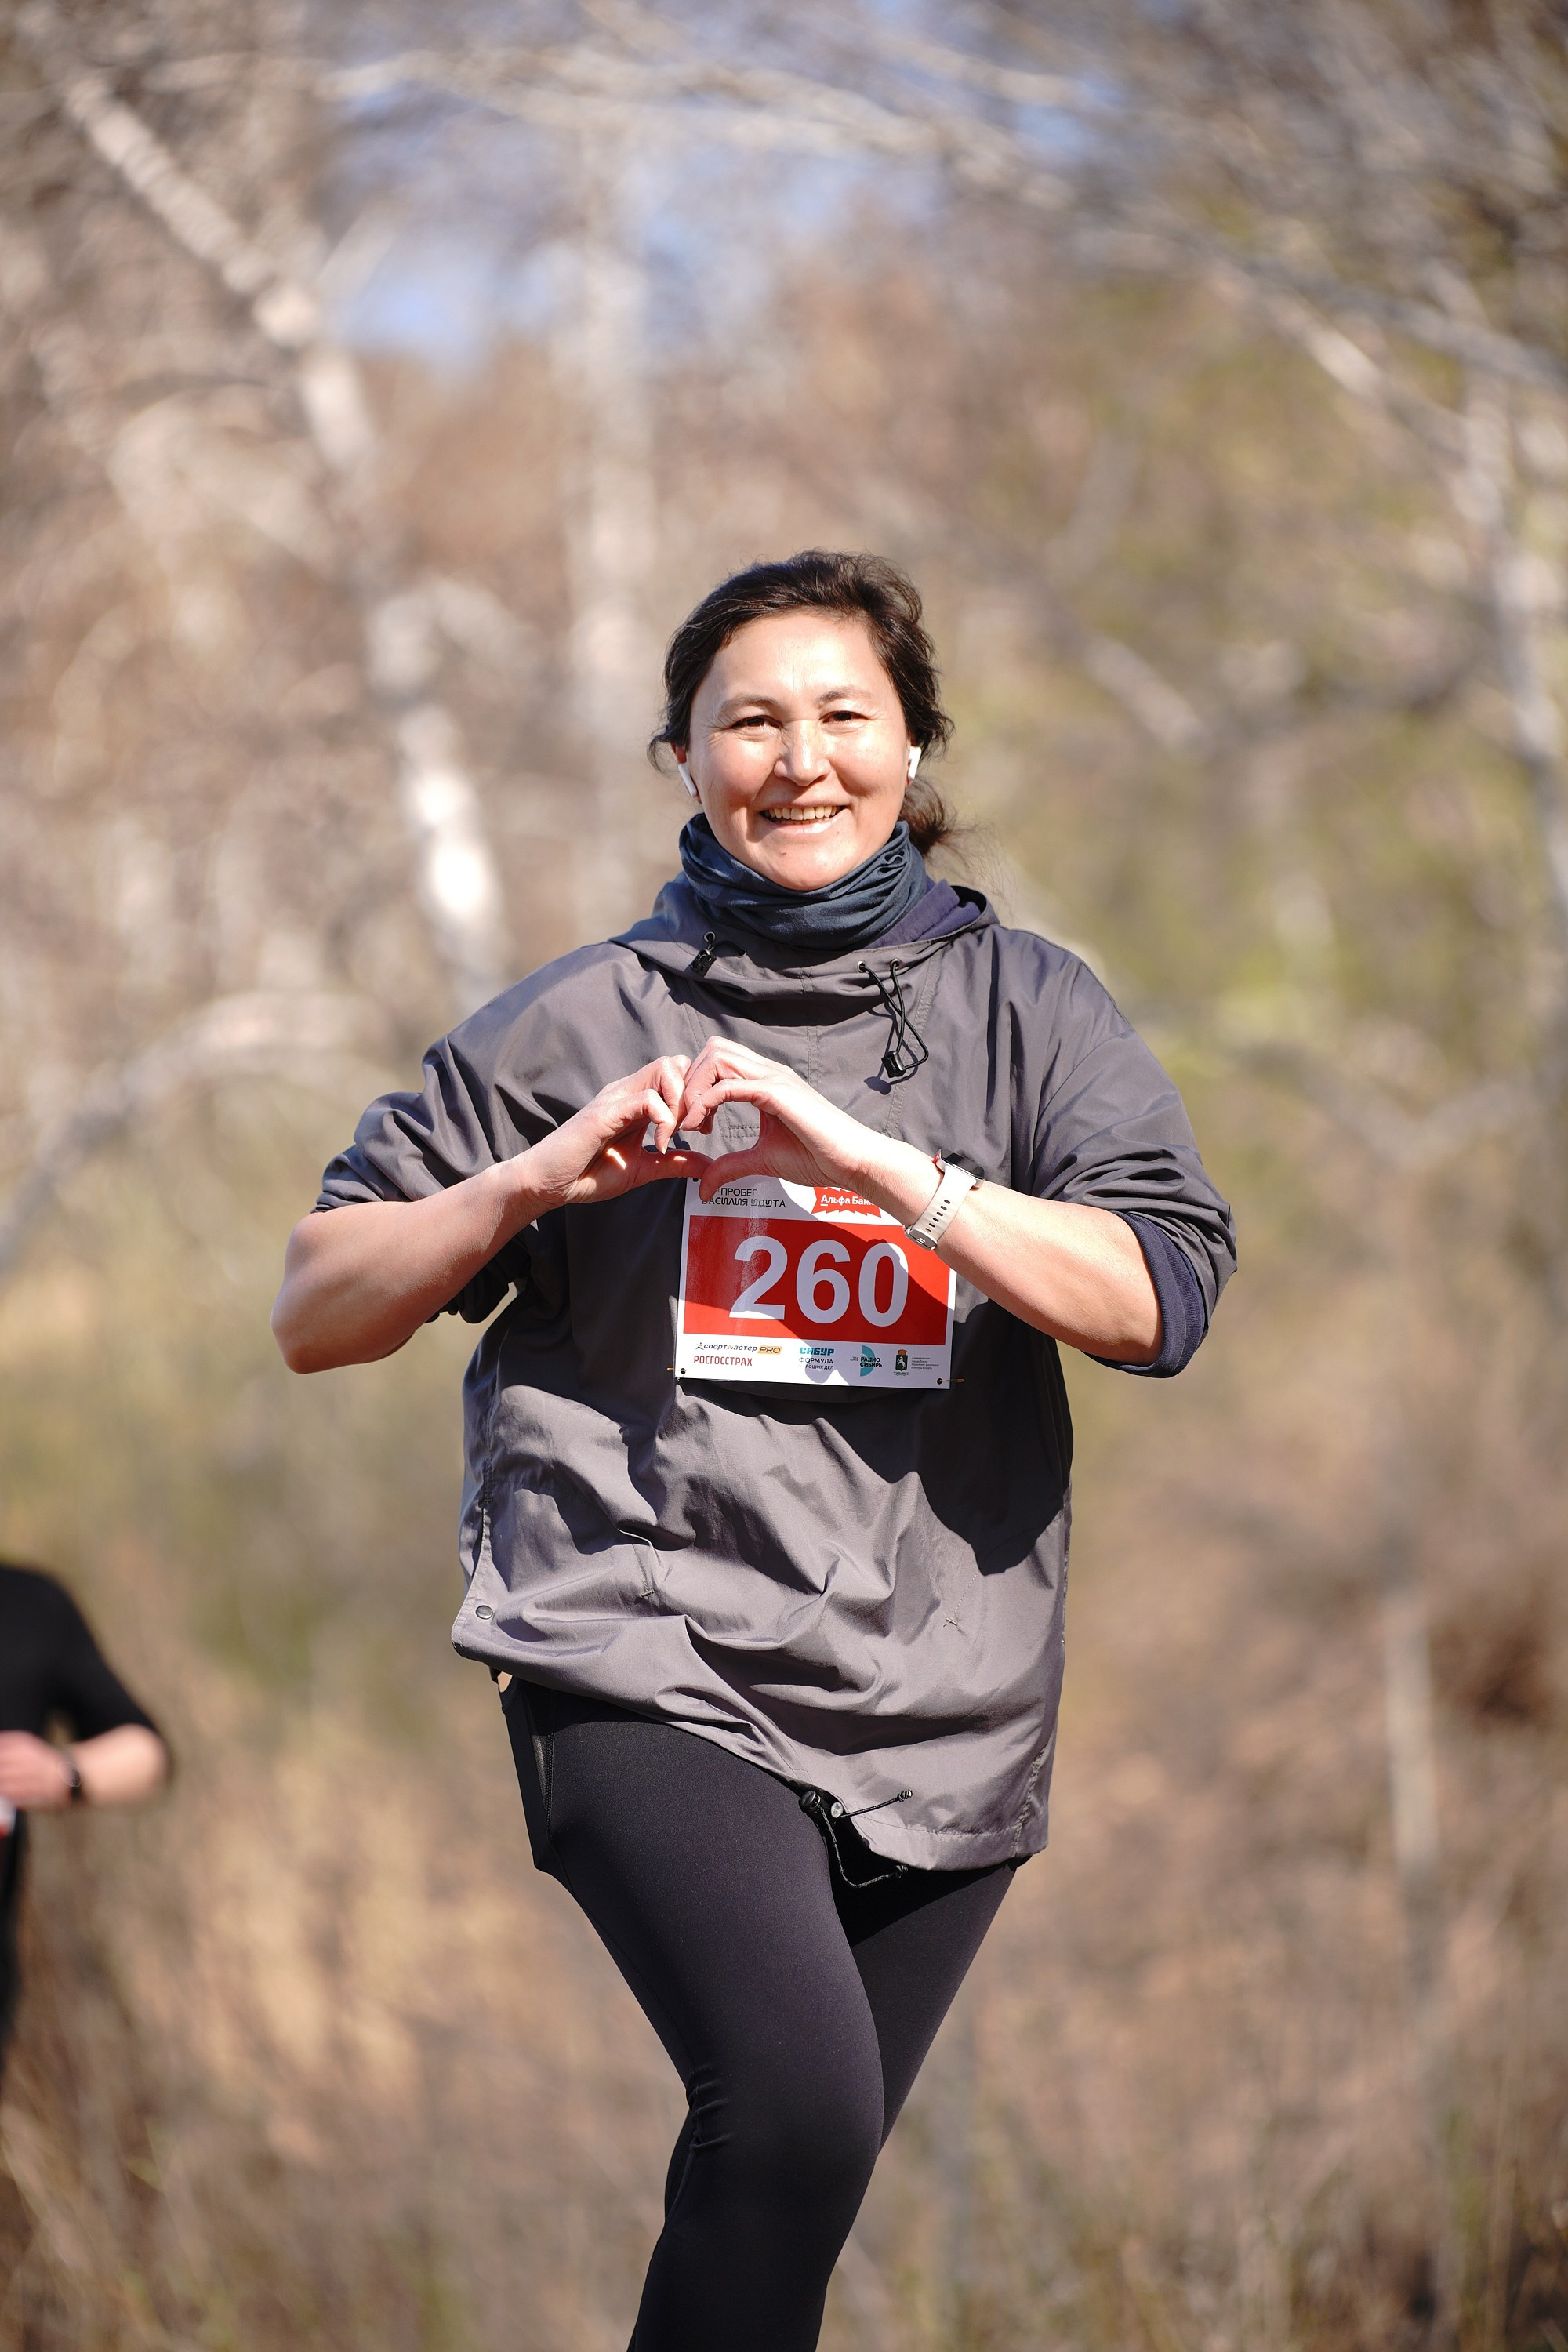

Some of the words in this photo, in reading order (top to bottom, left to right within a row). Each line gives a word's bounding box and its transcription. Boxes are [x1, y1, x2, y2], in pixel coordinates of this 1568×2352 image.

[720, 1188, 757, 1196] ПРОБЕГ
[820, 1194, 851, 1207] Альфа
[728, 1235, 909, 1327] 260
[799, 1347, 835, 1356] СИБУР
[693, 1355, 753, 1367] РОСГОССТРАХ
